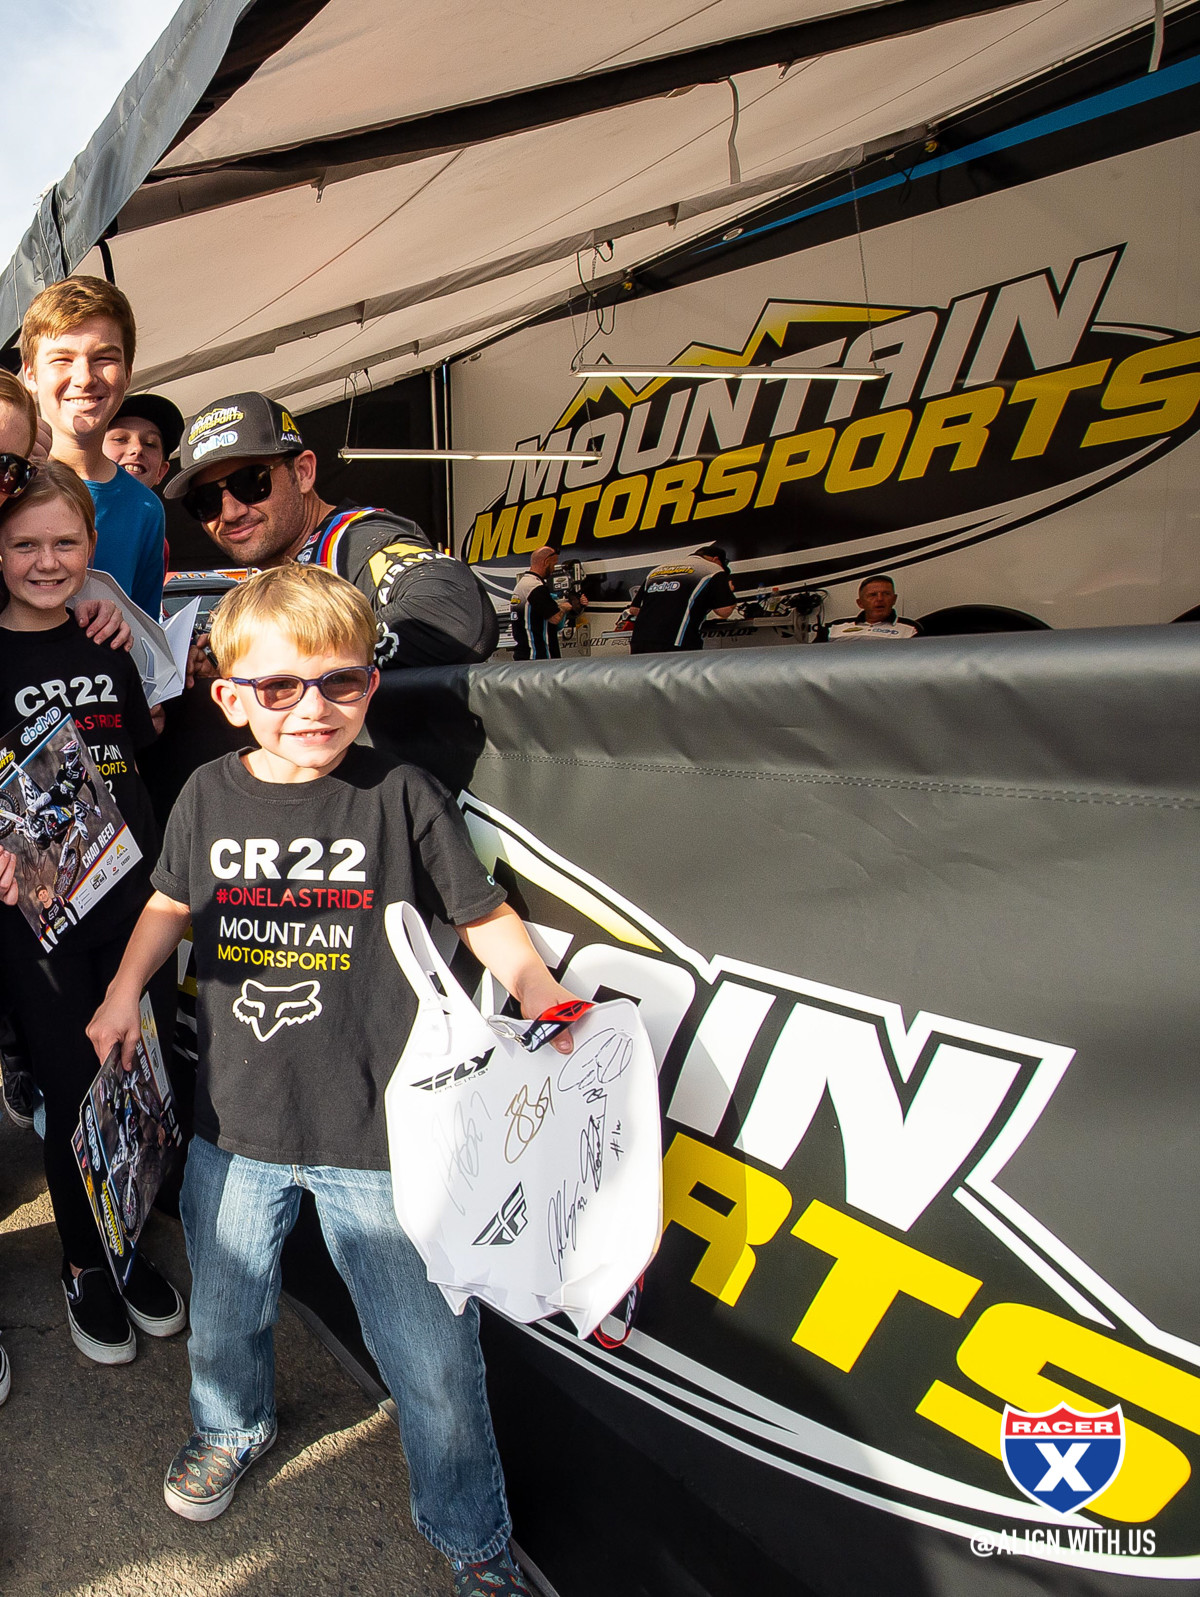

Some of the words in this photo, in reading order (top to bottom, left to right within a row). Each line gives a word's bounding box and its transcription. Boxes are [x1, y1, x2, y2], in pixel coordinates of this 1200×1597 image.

[504, 249, 1119, 507] MOUNTAIN
[467, 335, 1200, 565] MOTORSPORTS
[14, 674, 119, 717] CR22
[21, 707, 61, 746] cbdMD
[81, 842, 100, 869] CHAD
[97, 822, 115, 849] REED
[209, 837, 367, 883] CR22
[216, 887, 375, 910] #ONELASTRIDE
[218, 915, 354, 948] MOUNTAIN
[217, 944, 351, 971] MOTORSPORTS
[409, 1045, 497, 1091] FLY
